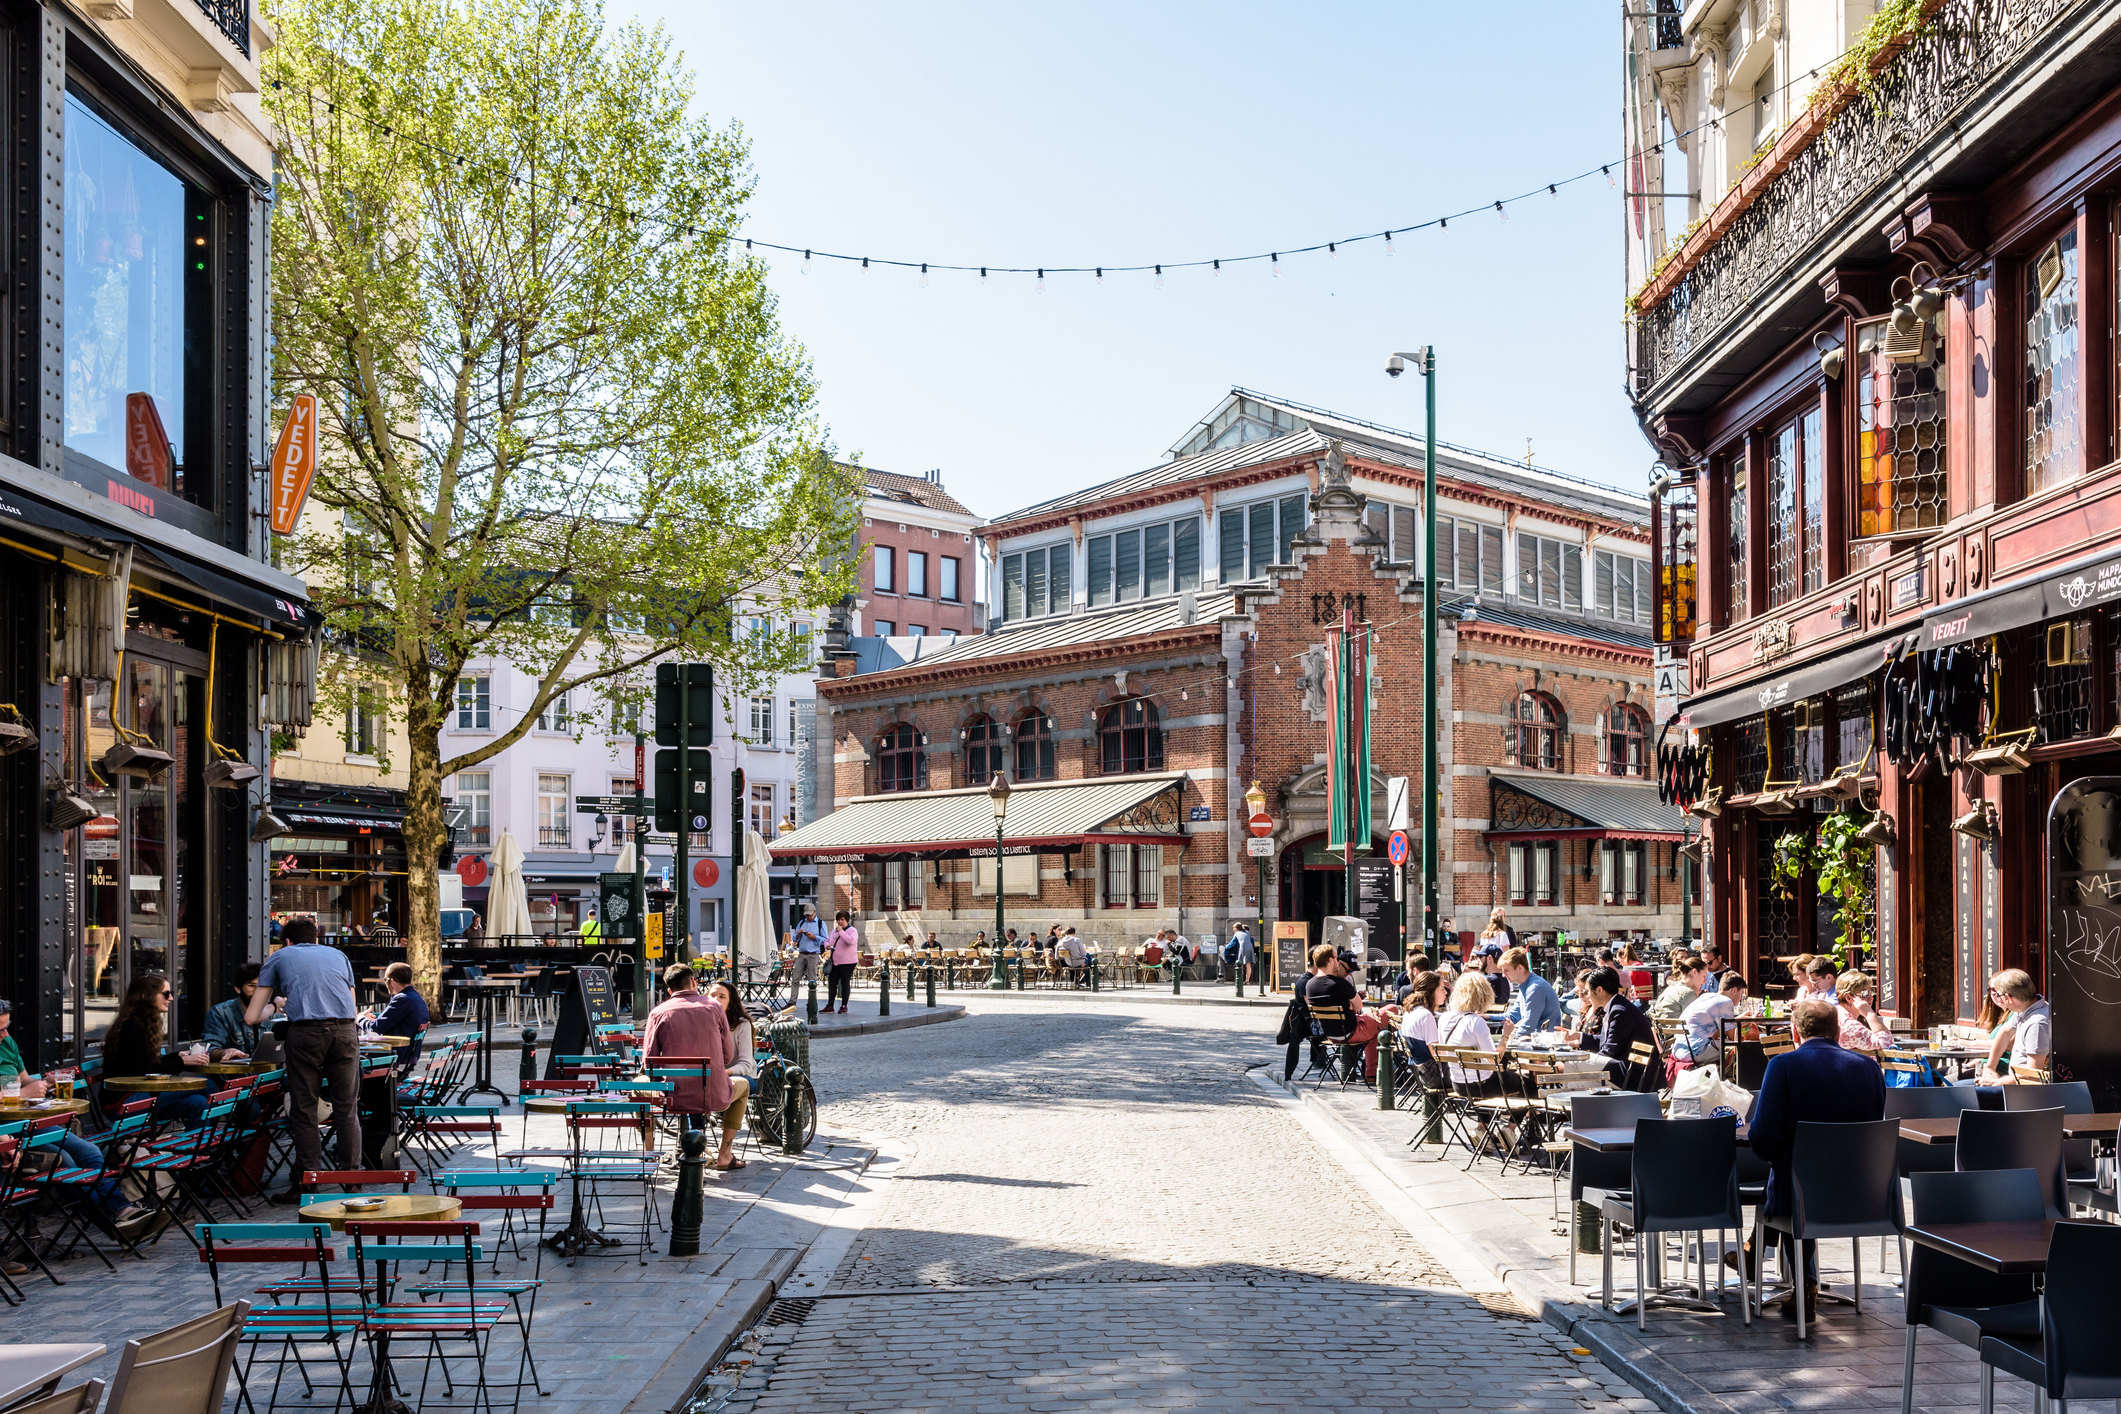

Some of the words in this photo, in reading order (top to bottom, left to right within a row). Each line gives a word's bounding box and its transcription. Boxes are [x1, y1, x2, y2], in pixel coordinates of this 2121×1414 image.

[277, 405, 309, 525] VEDETT
[1898, 576, 1919, 594] LILLET
[1751, 619, 1791, 652] JAMESON
[1932, 615, 1968, 642] VEDETT
[797, 722, 806, 758] ORLEY
[797, 761, 806, 783] VAN
[92, 875, 105, 885] ROI
[460, 864, 484, 874] CHILI
[696, 867, 717, 876] CHILI
